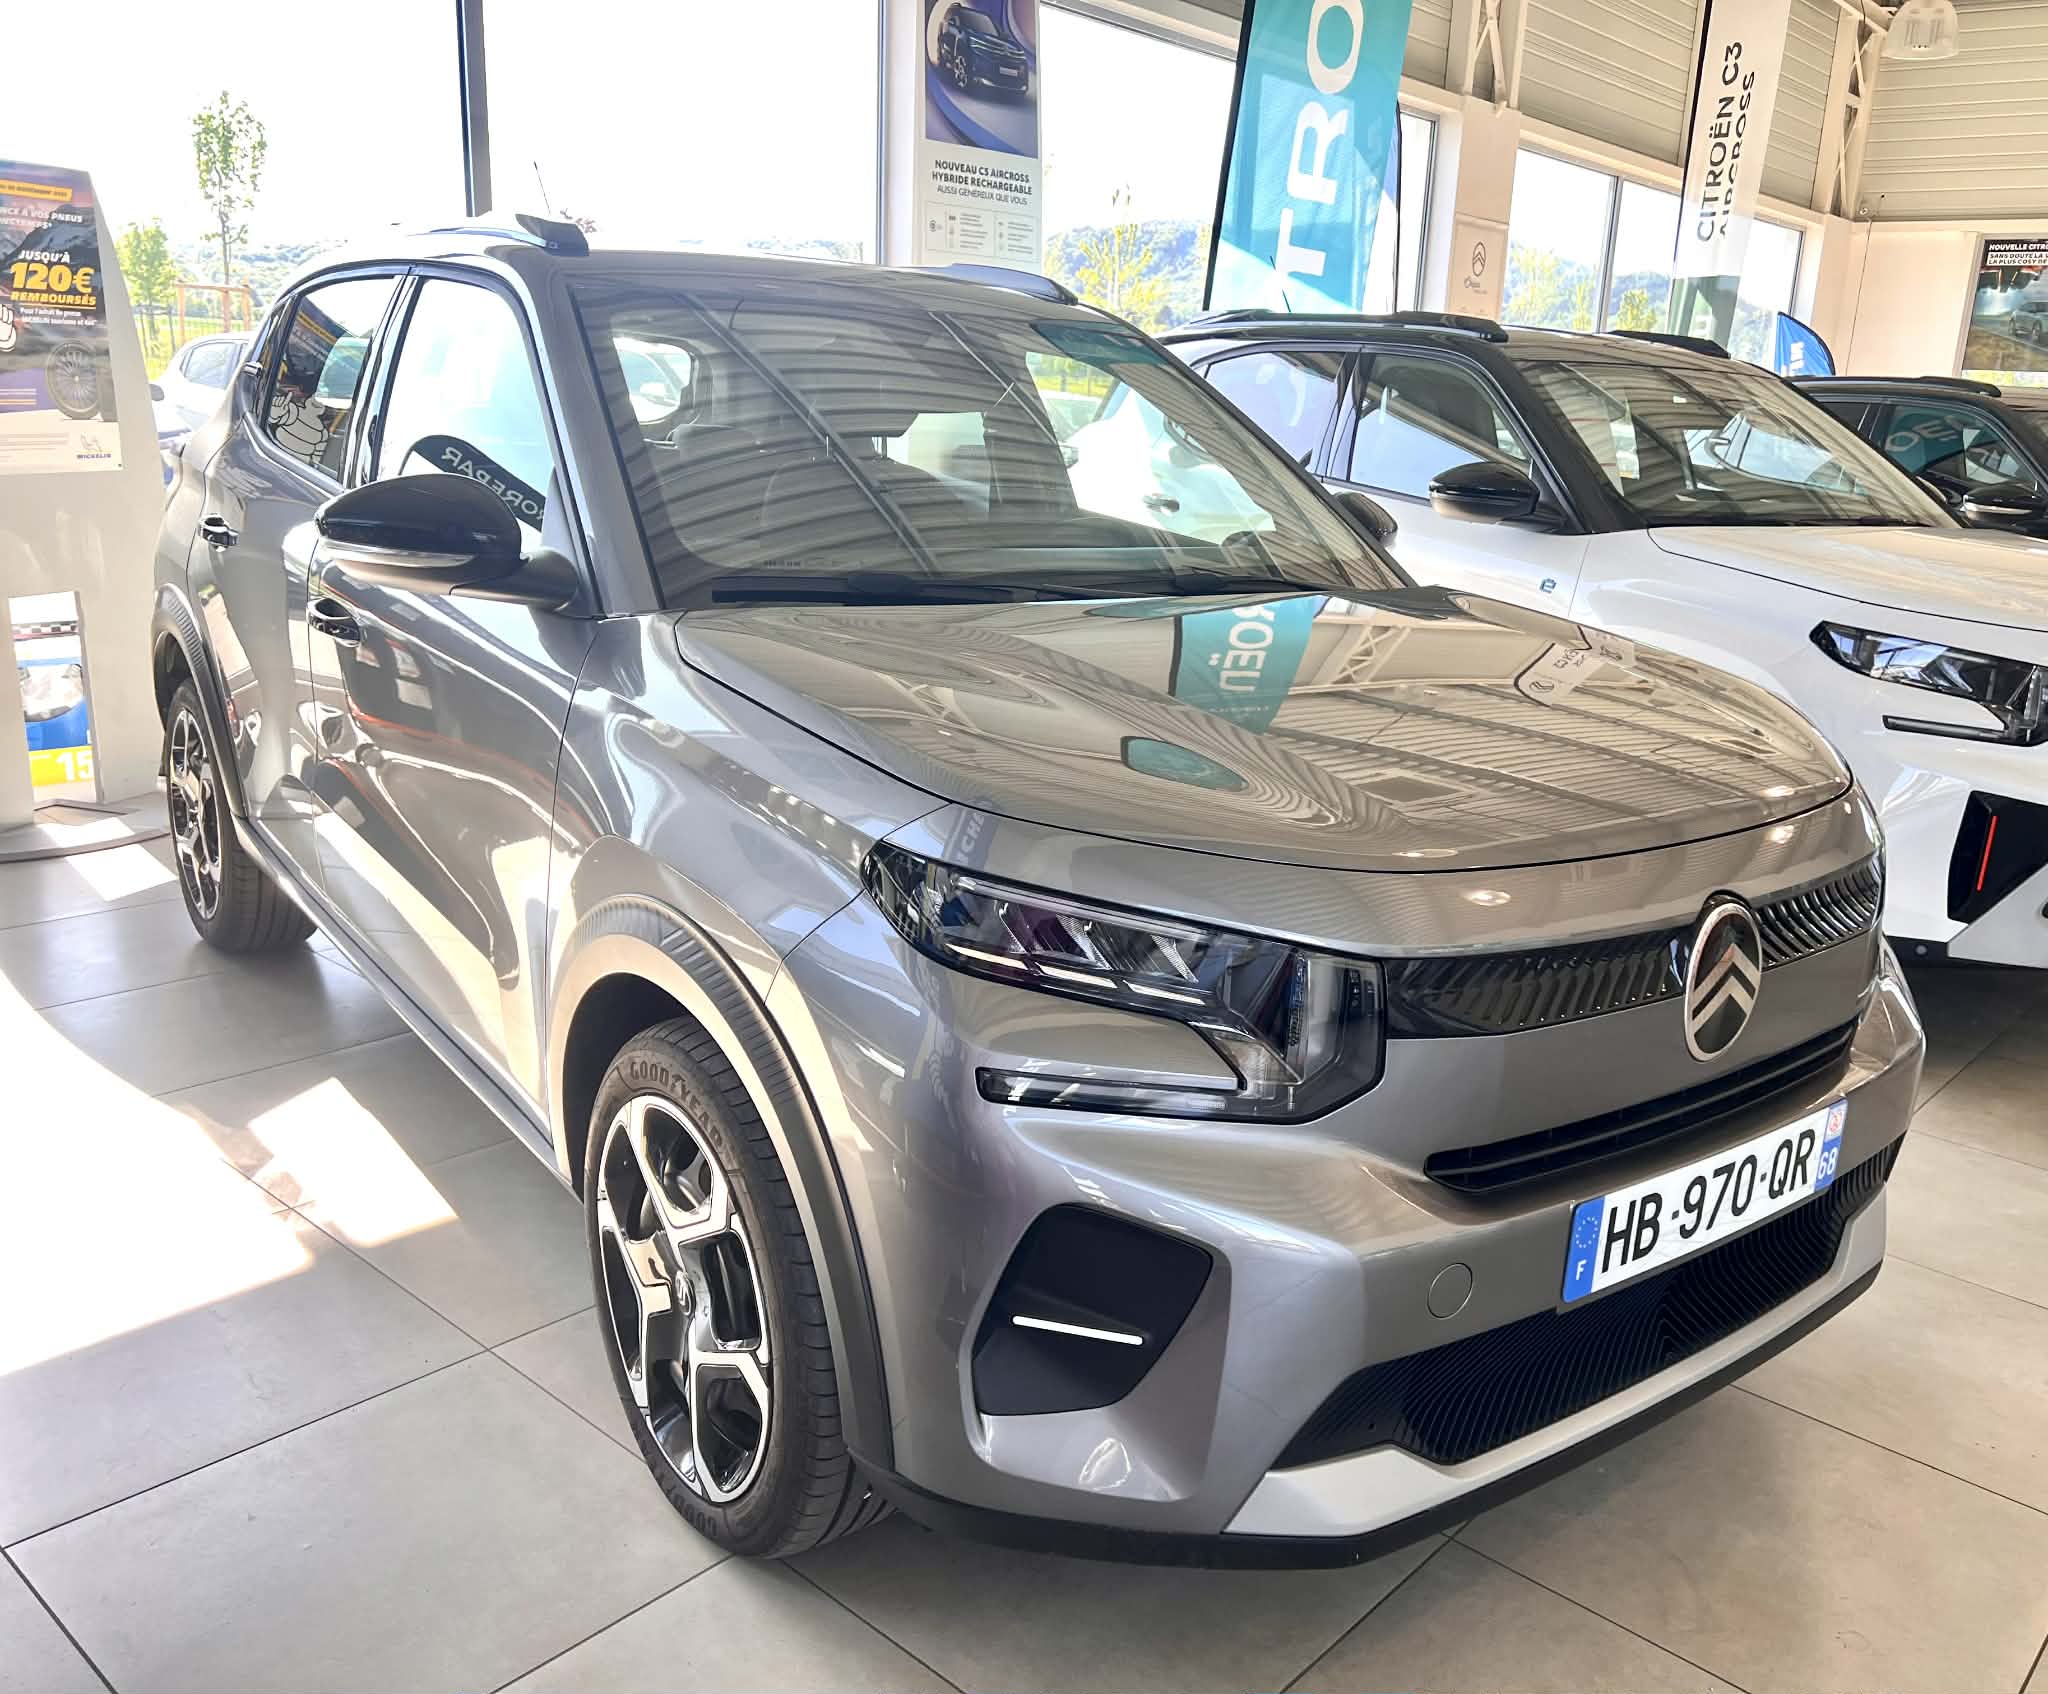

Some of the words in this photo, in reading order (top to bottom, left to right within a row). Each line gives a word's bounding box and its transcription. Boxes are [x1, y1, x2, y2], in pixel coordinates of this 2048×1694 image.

[1697, 96, 1735, 242] CITROËN
[1722, 42, 1742, 86] C3
[932, 171, 968, 185] HYBRIDE
[970, 177, 1032, 195] RECHARGEABLE
[935, 160, 977, 174] NOUVEAU
[978, 167, 989, 176] C5
[990, 168, 1030, 183] AIRCROSS
[937, 185, 957, 195] AUSSI
[995, 193, 1009, 203] QUE
[1010, 196, 1028, 205] VOUS
[51, 212, 83, 223] PNEUS
[18, 250, 71, 264] JUSQU'À
[1989, 243, 2028, 251] NOUVELLE
[10, 262, 95, 293] 120€
[10, 291, 97, 306] REMBOURSÉS
[629, 1060, 724, 1148] GOODYEAR
[1817, 1147, 1838, 1182] 68
[1600, 1128, 1816, 1274] HB-970-QR
[1575, 1259, 1587, 1281] F
